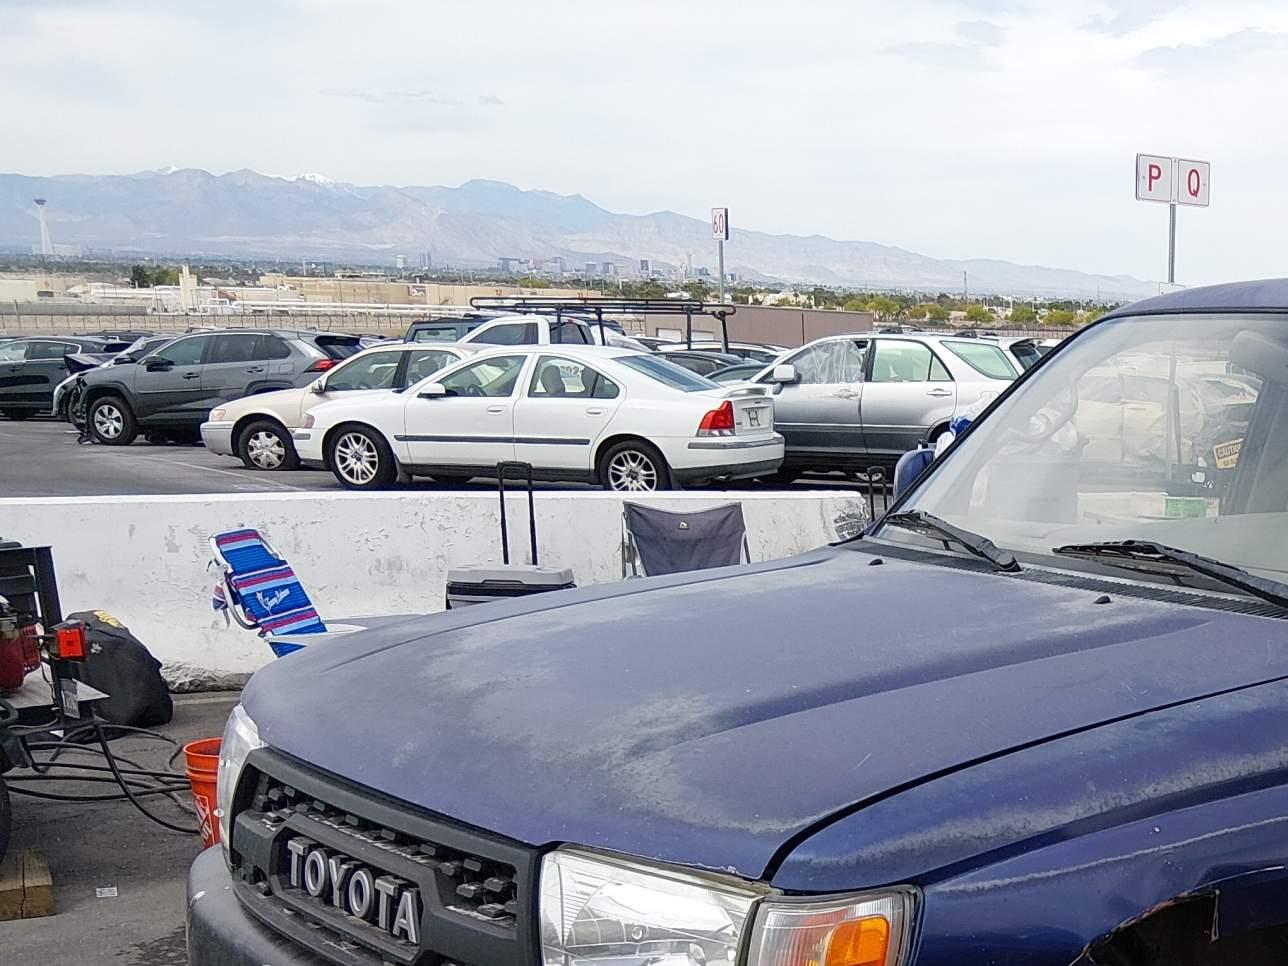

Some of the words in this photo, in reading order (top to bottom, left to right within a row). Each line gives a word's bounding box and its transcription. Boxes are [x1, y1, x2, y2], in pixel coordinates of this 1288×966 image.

[1148, 164, 1162, 191] P
[1187, 168, 1200, 198] Q
[1217, 443, 1241, 457] CAUTIO
[287, 837, 418, 944] TOYOTA
